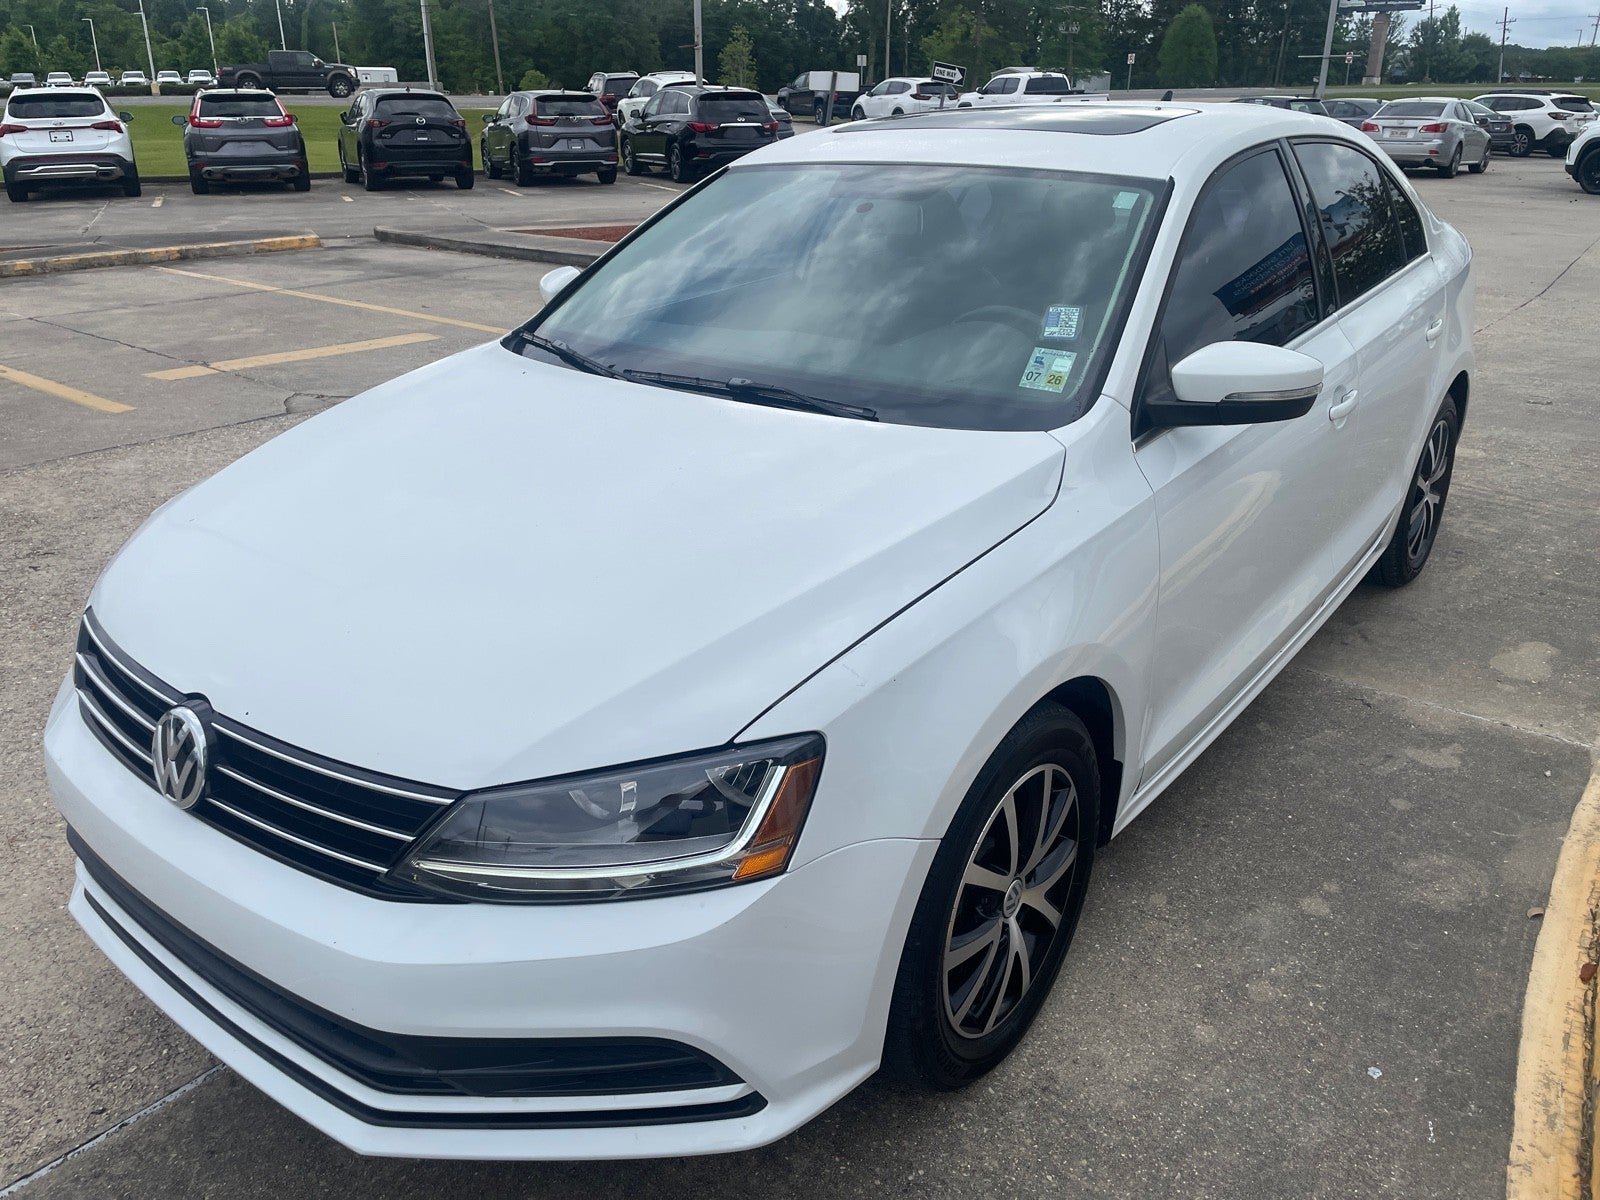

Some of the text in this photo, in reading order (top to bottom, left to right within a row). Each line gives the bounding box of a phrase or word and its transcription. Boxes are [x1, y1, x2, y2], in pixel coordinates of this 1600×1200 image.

[936, 68, 957, 79] ONE WAY
[1026, 371, 1062, 385] 07 26
